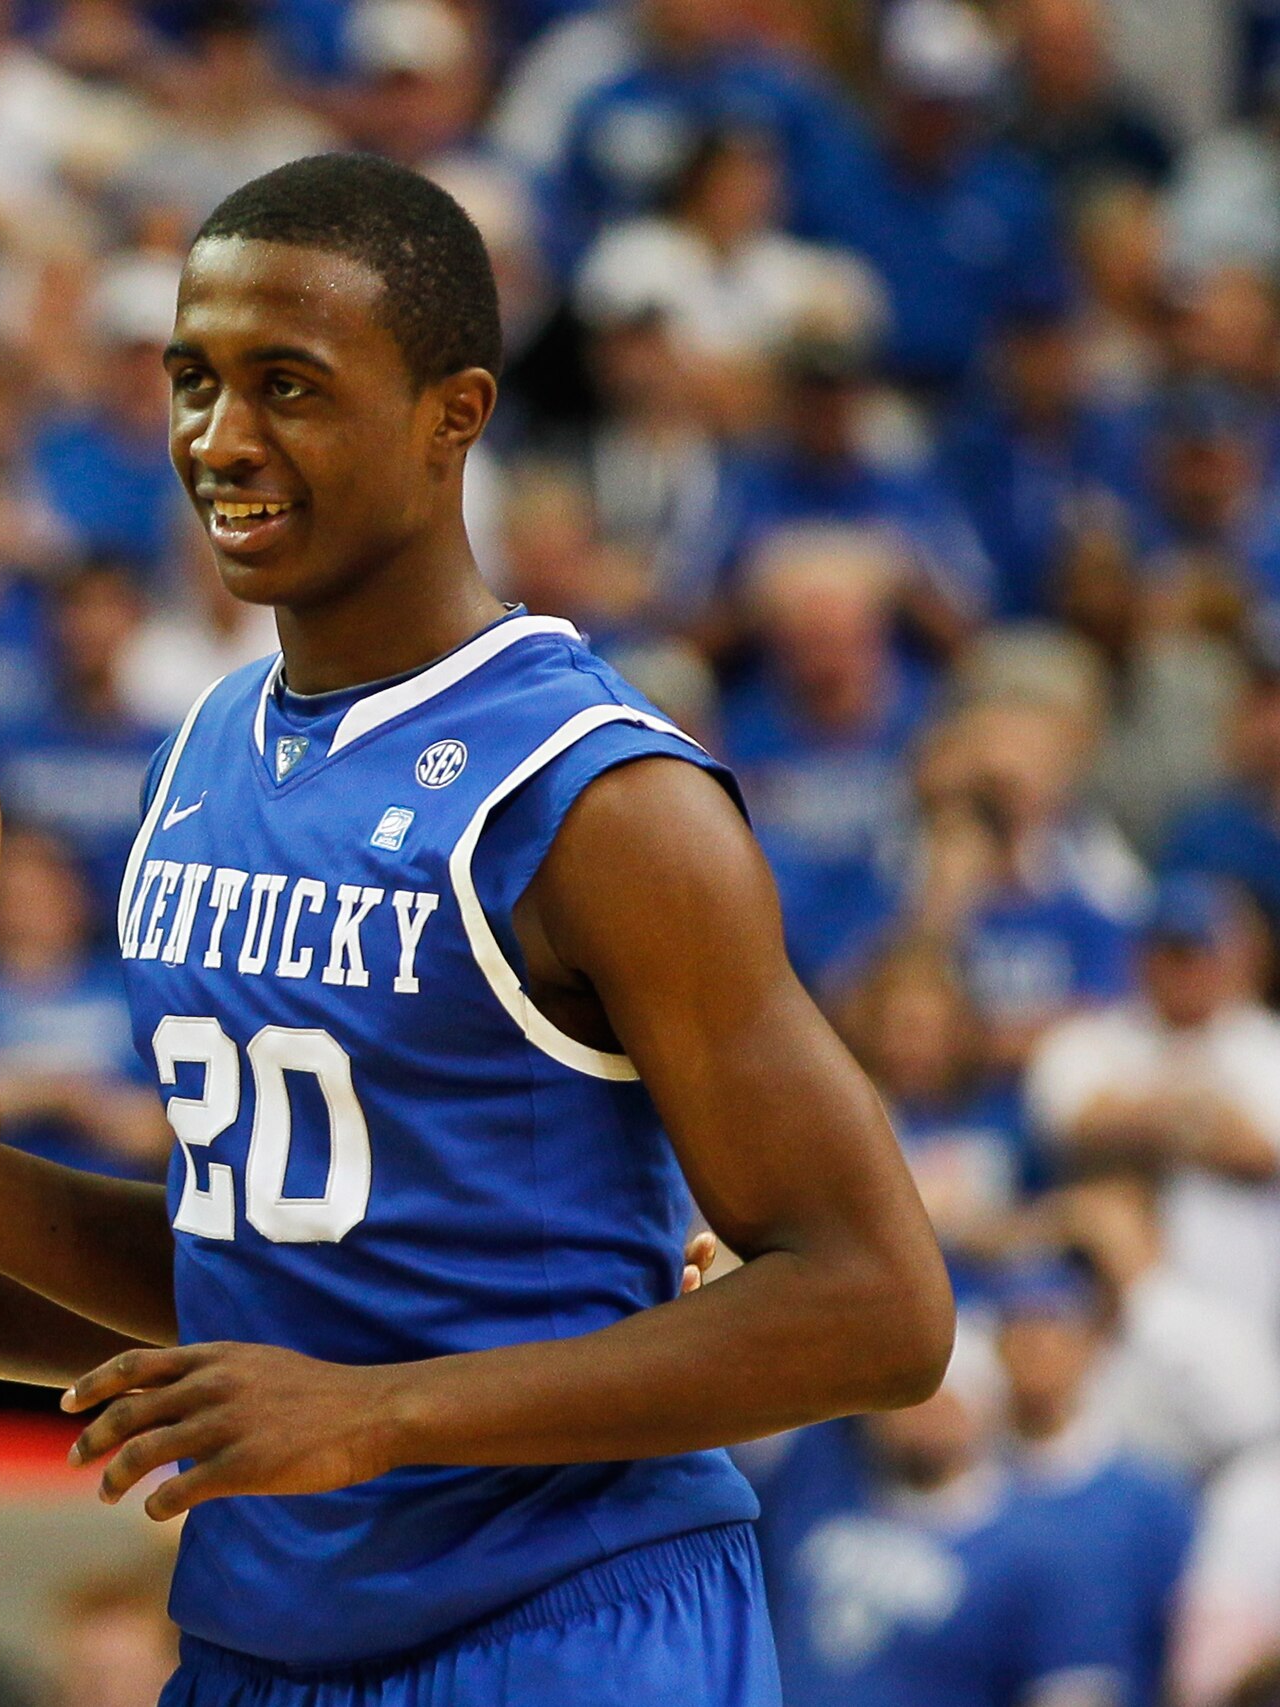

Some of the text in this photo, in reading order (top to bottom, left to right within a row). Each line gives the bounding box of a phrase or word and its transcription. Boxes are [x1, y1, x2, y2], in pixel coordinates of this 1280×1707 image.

[419, 743, 463, 785] SEC
[121, 859, 439, 993] KENTUCKY
[152, 1014, 371, 1243] 20
